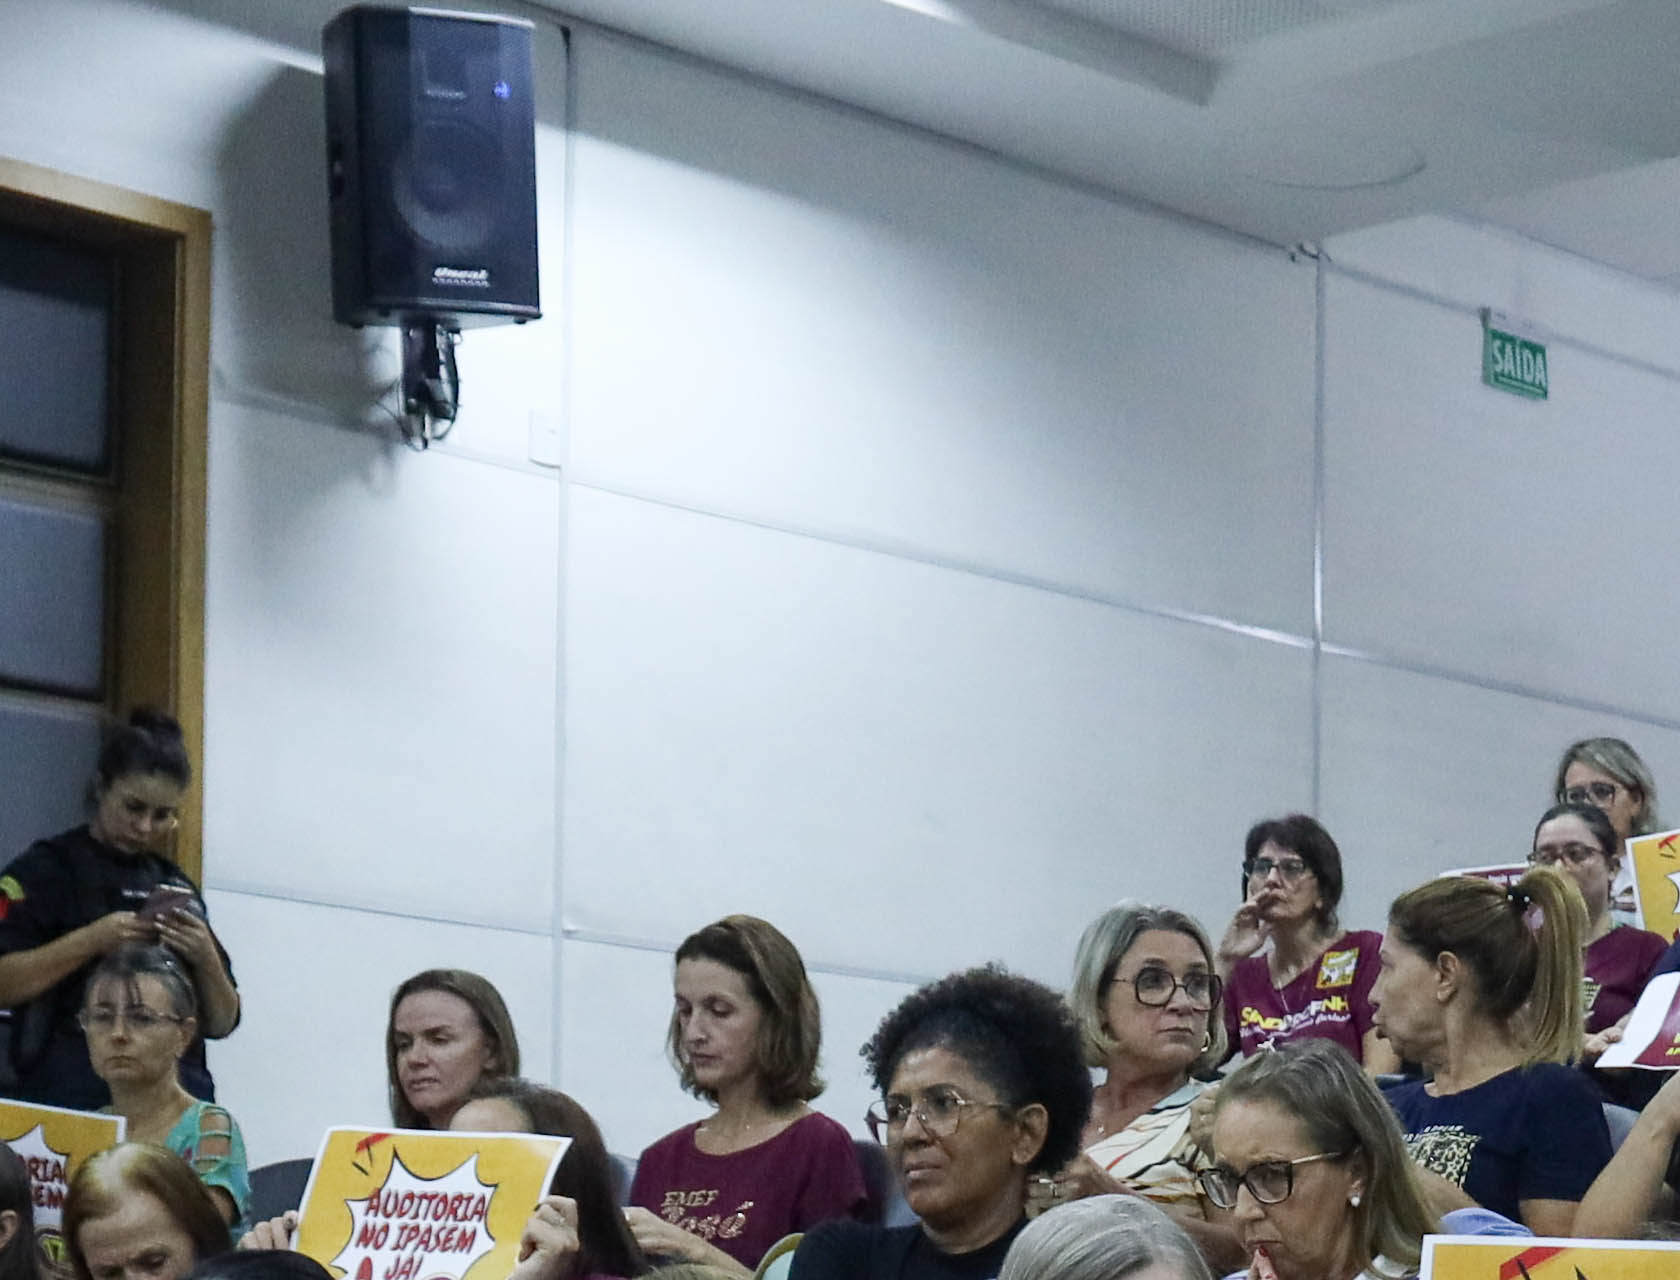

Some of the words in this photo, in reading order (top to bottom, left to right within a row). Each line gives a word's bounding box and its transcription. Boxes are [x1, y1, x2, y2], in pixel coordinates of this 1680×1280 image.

[1493, 338, 1546, 387] SAÍDA
[364, 1187, 487, 1224] AUDITORIA
[358, 1223, 389, 1250] NO
[393, 1223, 476, 1255] IPASEM
